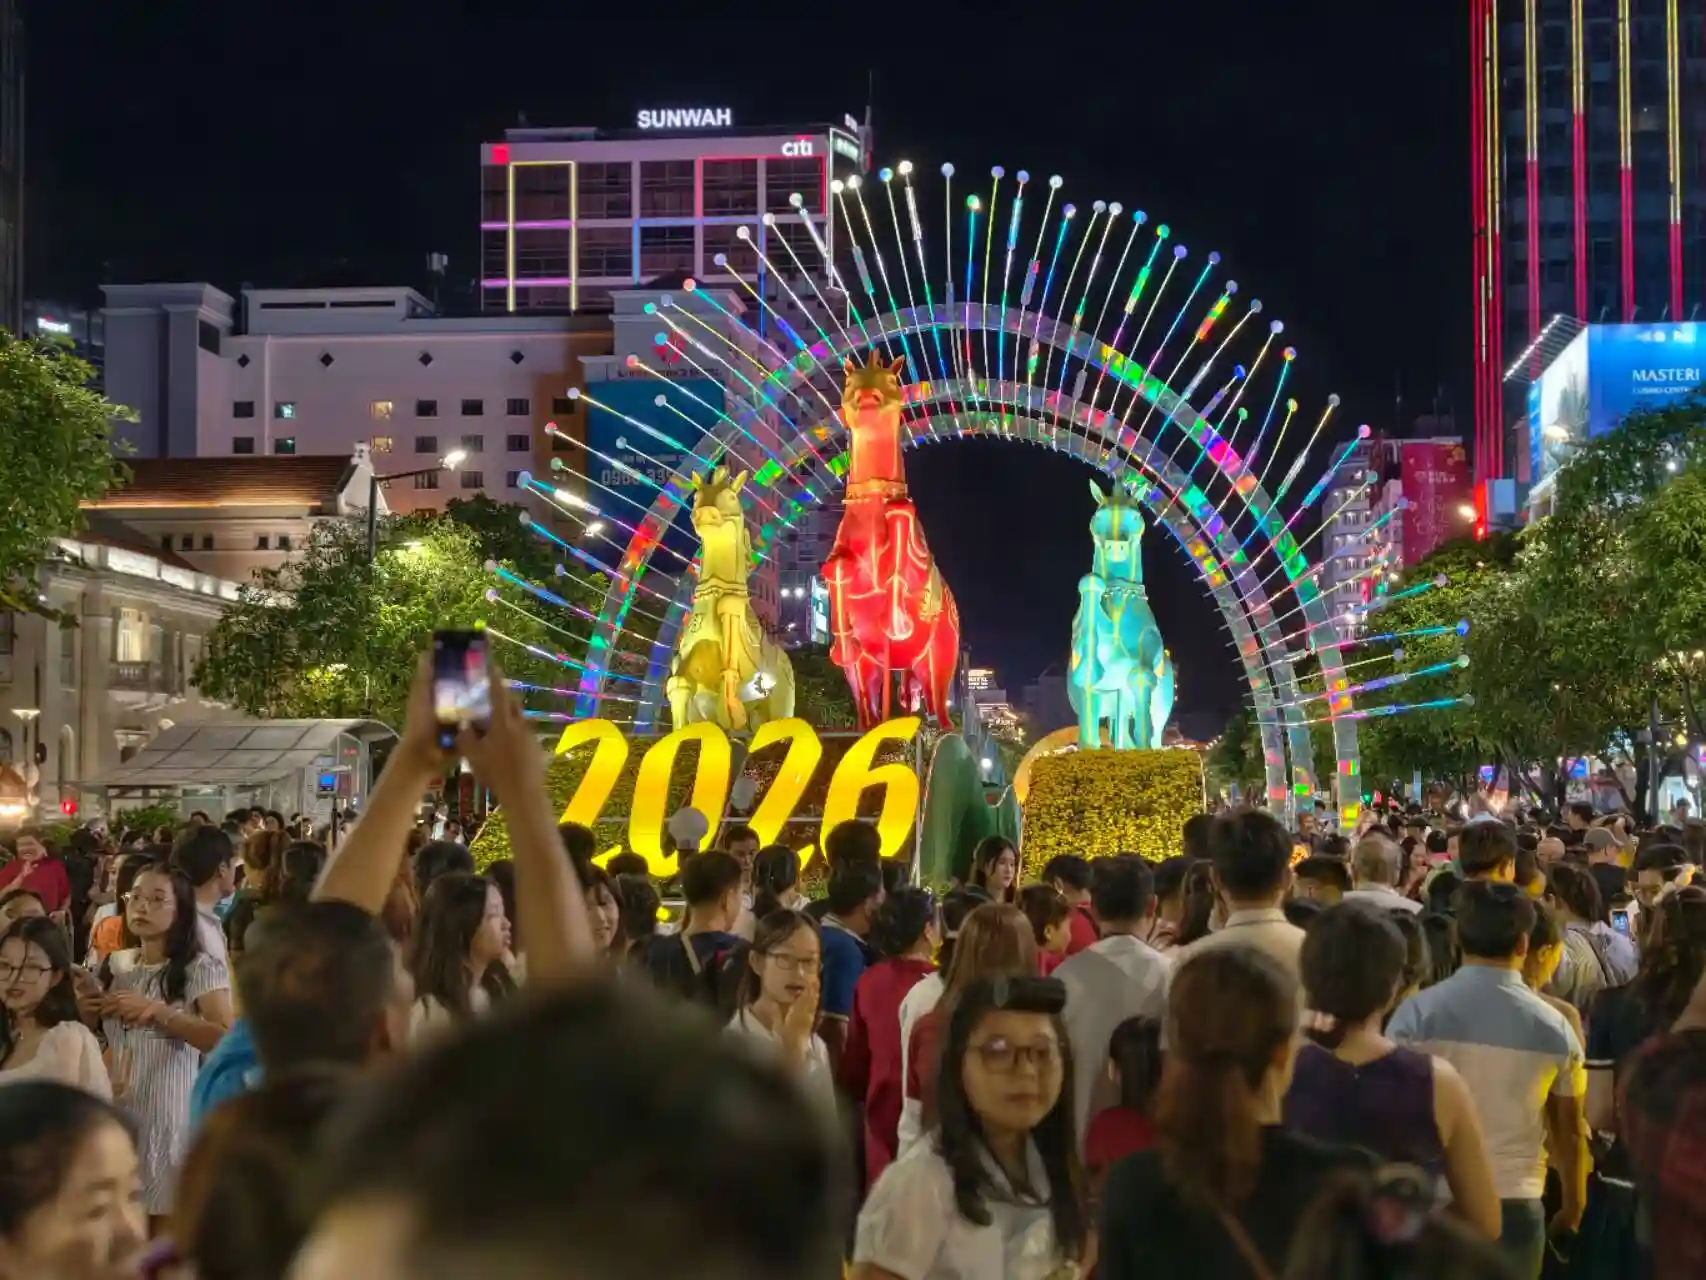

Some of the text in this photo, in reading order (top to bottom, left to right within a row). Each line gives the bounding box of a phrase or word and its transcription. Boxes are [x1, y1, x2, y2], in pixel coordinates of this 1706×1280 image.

[637, 107, 732, 129] SUNWAH
[781, 139, 813, 156] citi
[1632, 368, 1700, 382] MASTERI
[555, 718, 921, 876] 2026
